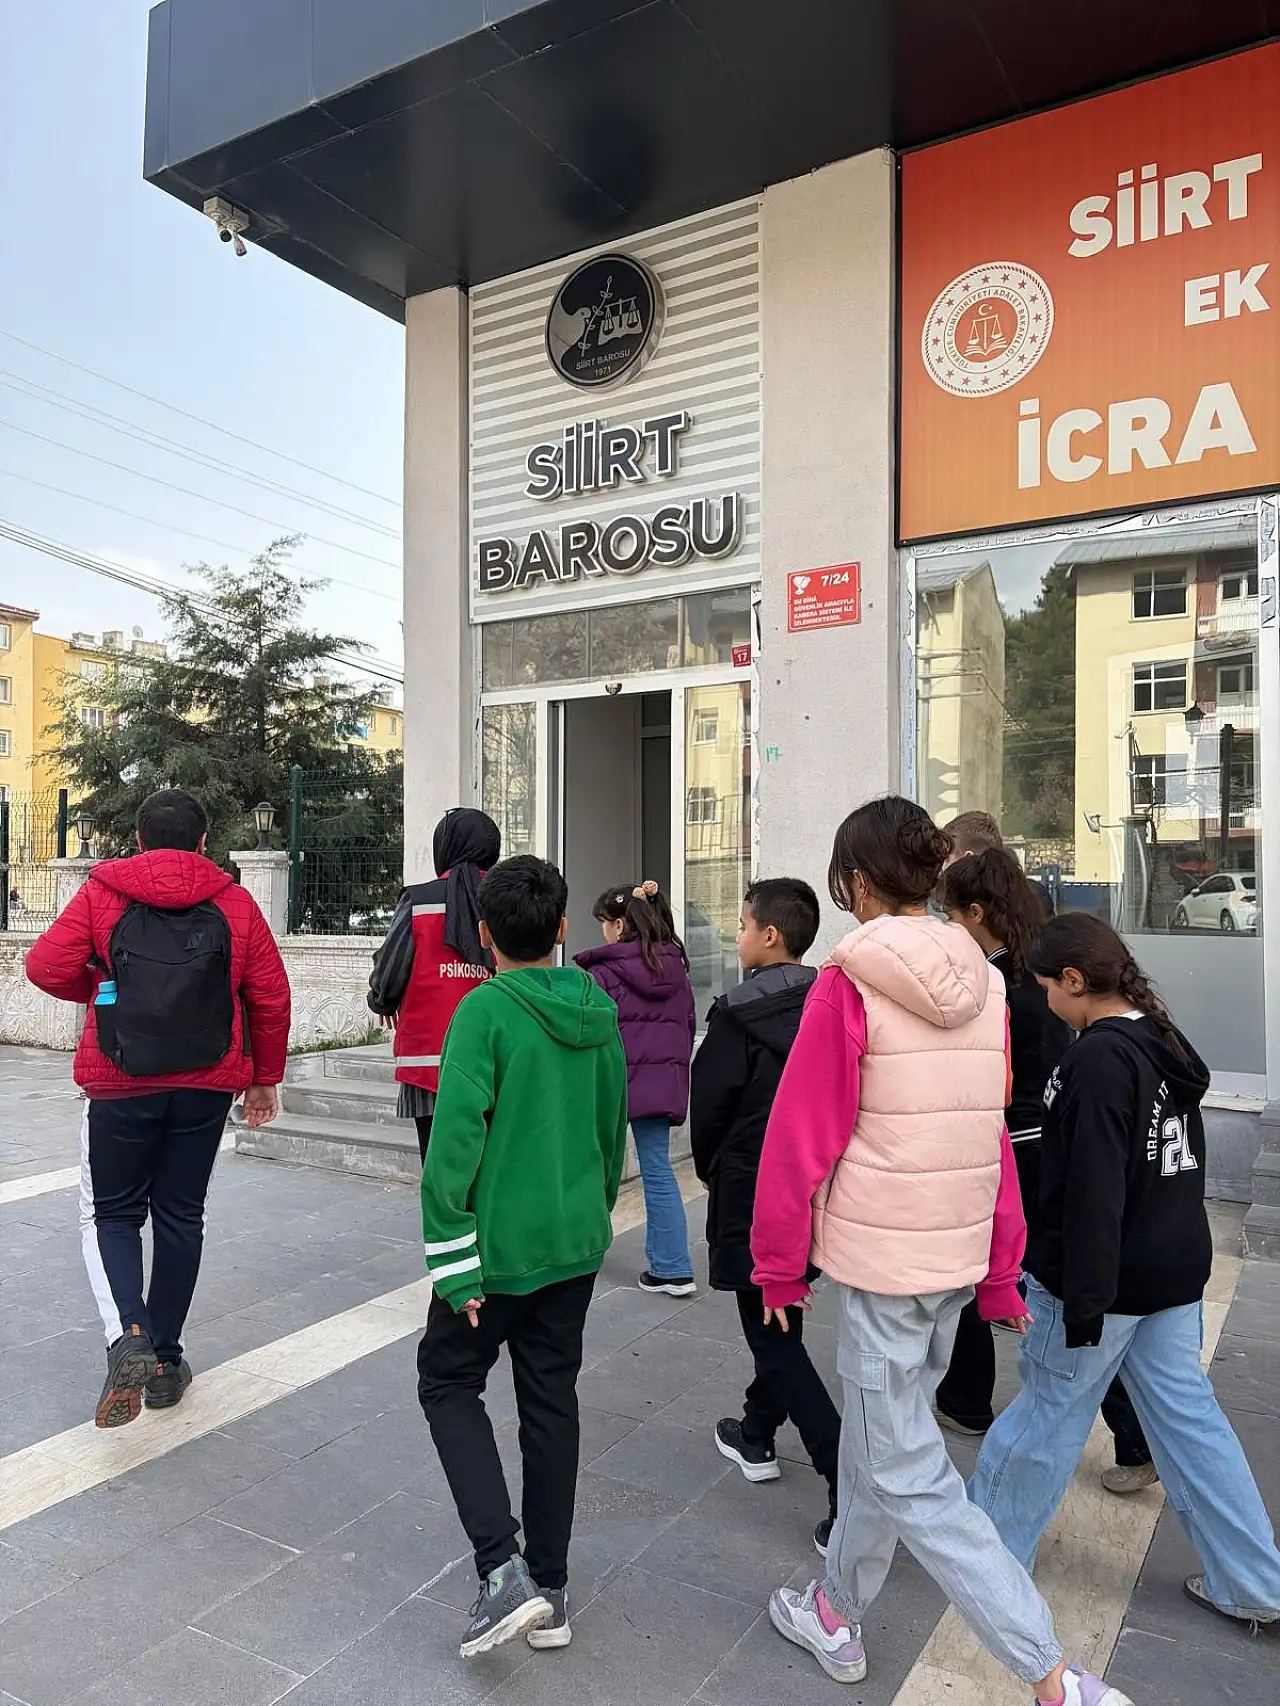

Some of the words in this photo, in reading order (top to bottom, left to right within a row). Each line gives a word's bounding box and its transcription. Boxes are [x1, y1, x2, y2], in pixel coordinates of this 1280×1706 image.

[1067, 153, 1262, 258] SİİRT
[993, 289, 1022, 308] ADALET
[1184, 263, 1270, 326] EK
[597, 349, 631, 364] BAROSU
[524, 410, 691, 500] SİİRT
[1018, 381, 1257, 489] İCRA
[478, 492, 743, 593] BAROSU
[821, 572, 849, 586] 7/24
[737, 652, 748, 662] 17
[439, 960, 493, 979] PSİKOSOS
[1147, 1100, 1162, 1161] DREAM
